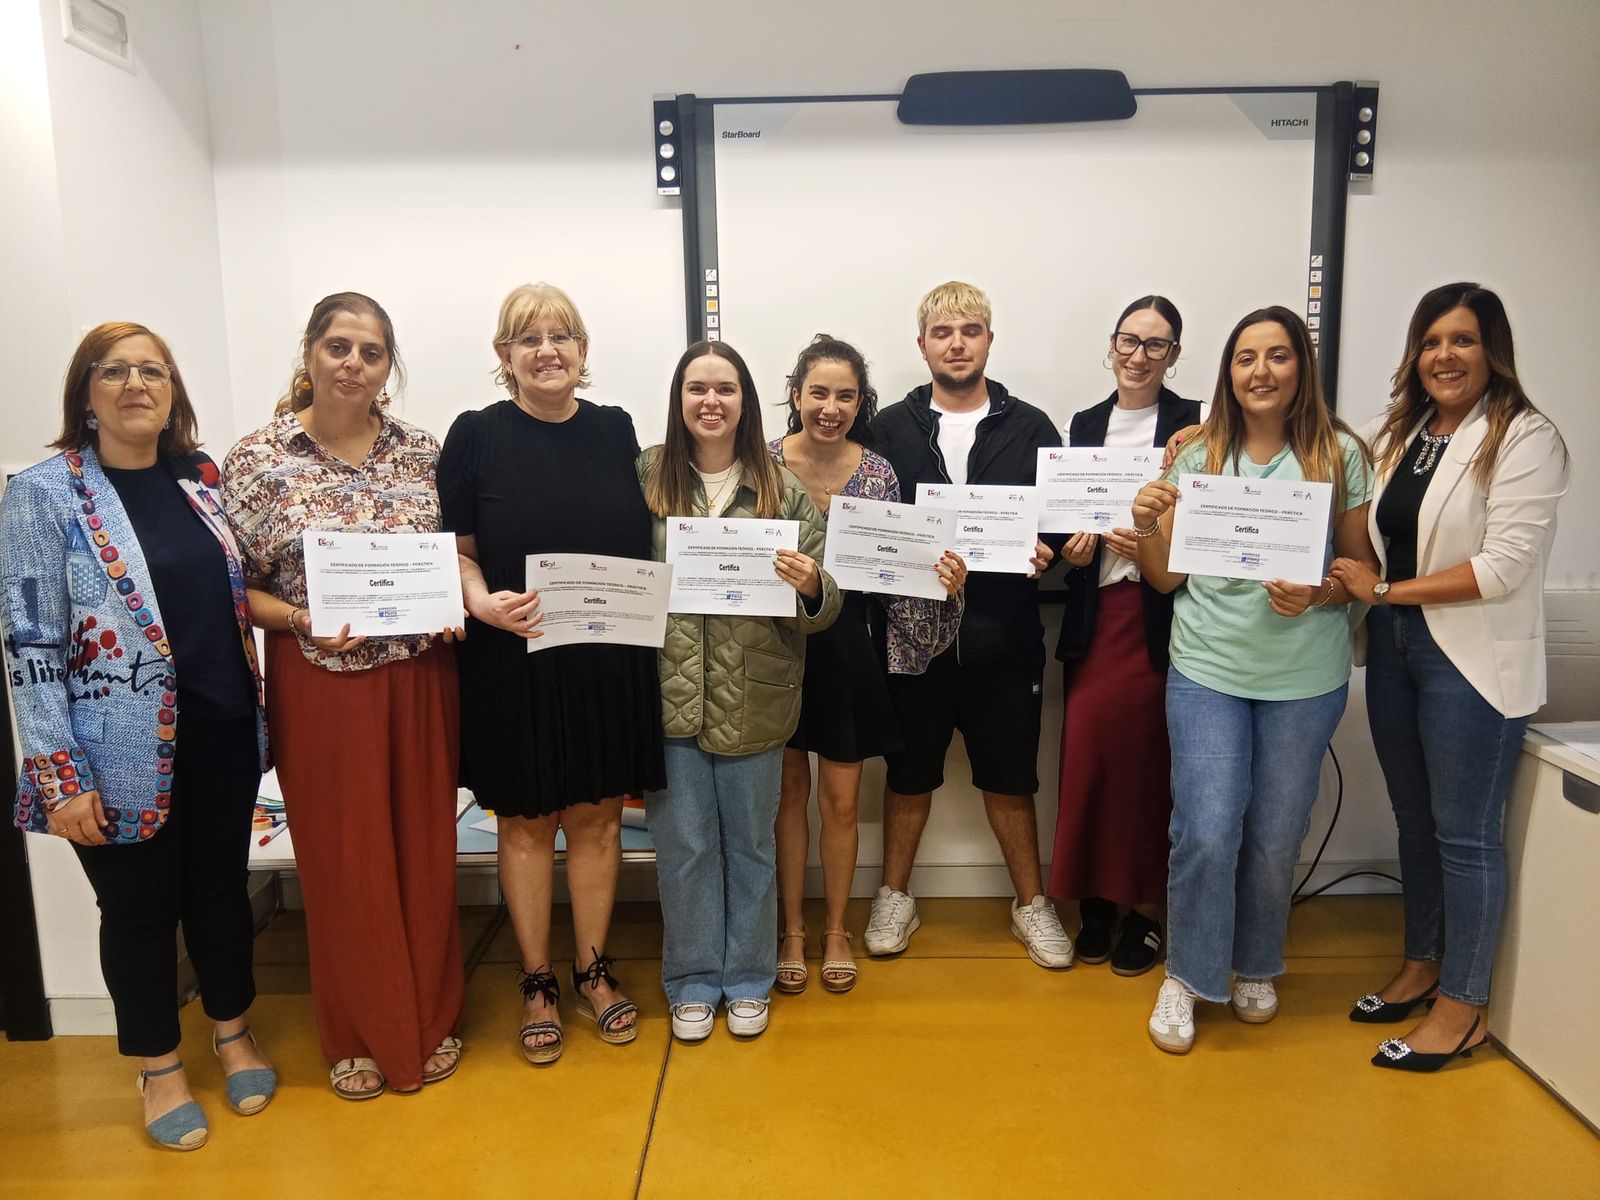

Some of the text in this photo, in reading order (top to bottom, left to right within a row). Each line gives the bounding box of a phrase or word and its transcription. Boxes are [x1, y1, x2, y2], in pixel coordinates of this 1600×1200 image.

[1271, 119, 1309, 127] HITACHI
[722, 131, 760, 139] StarBoard
[1235, 525, 1259, 534] Certifica
[877, 545, 897, 554] Certifica
[370, 579, 394, 587] Certifica
[584, 597, 606, 605] Certifica
